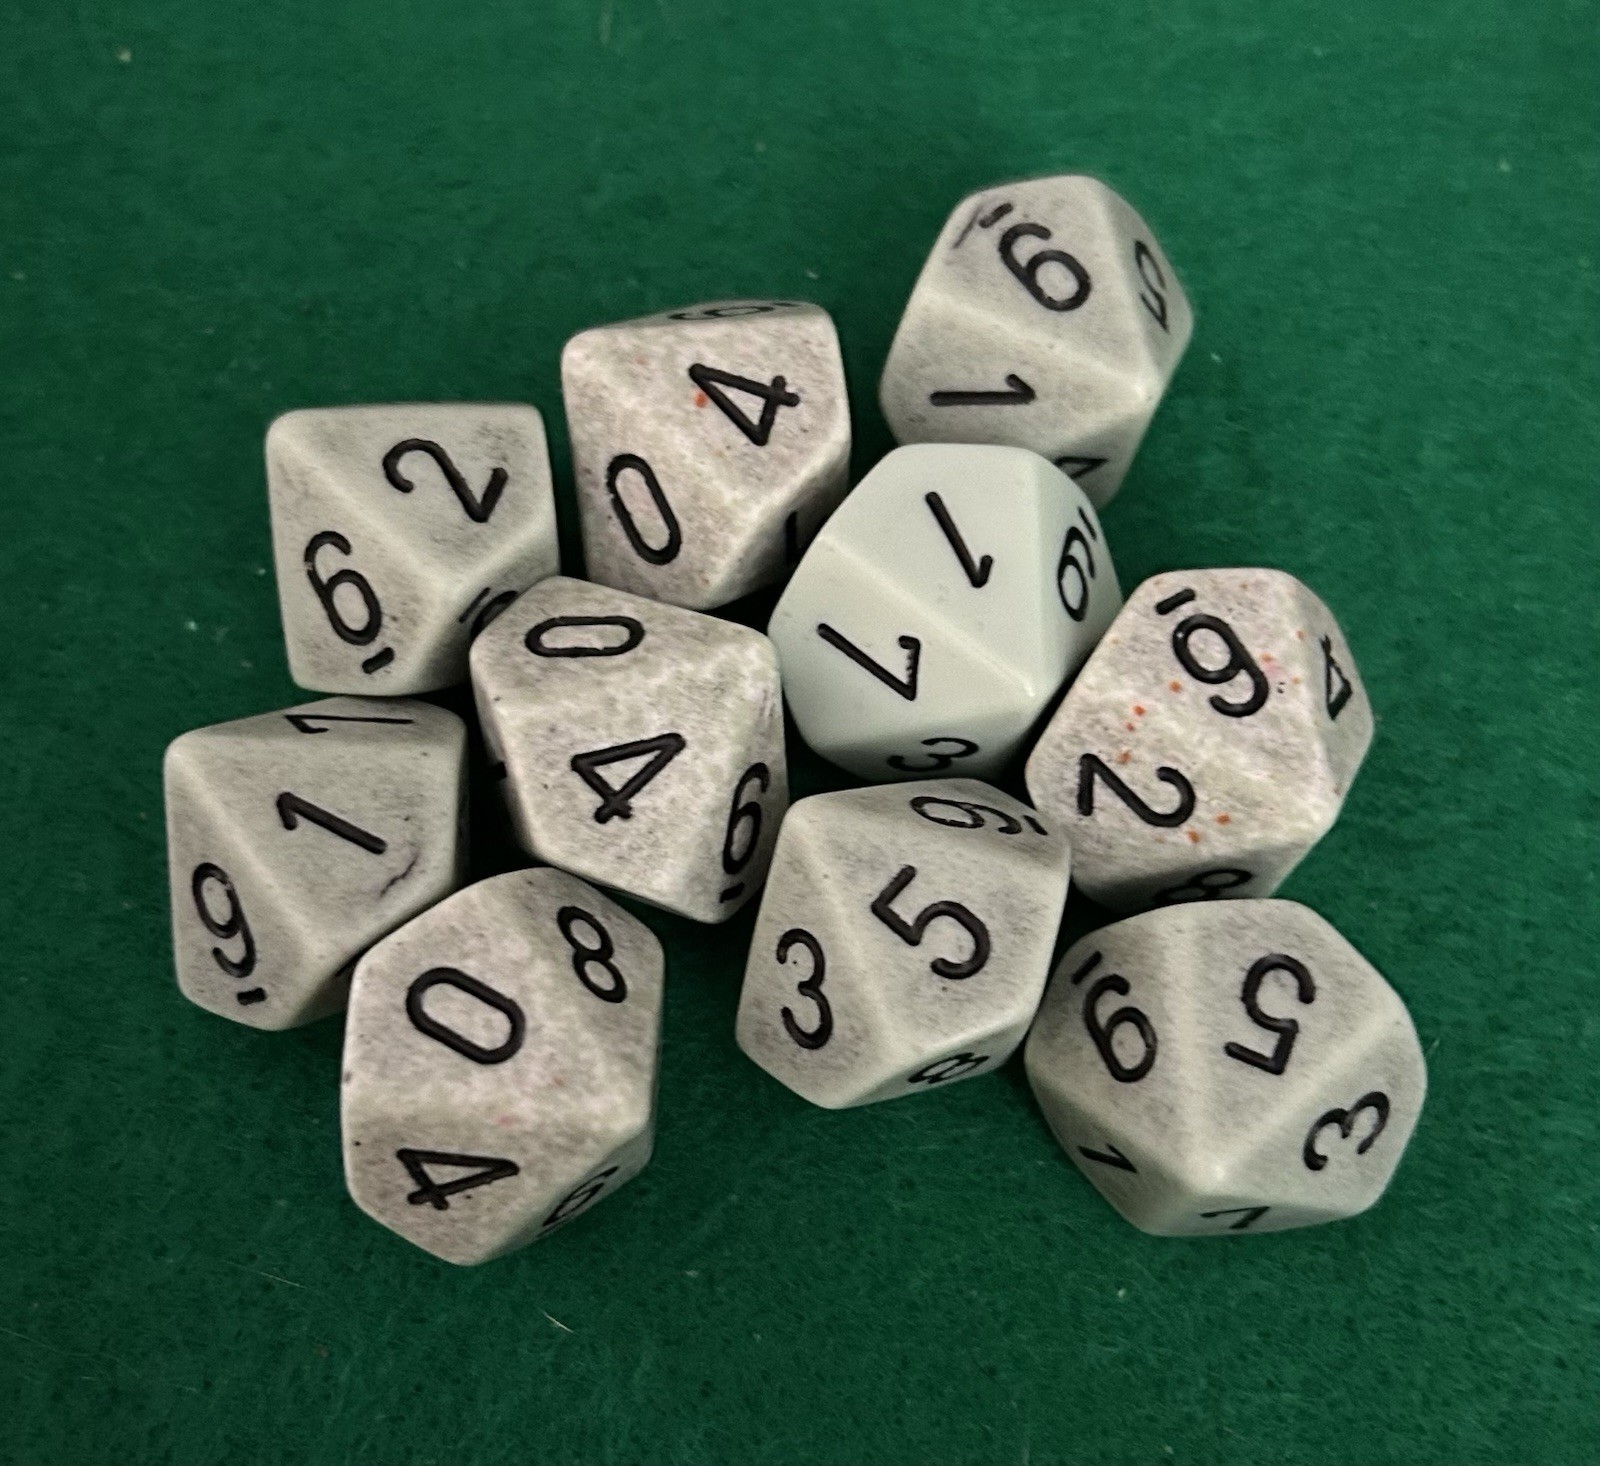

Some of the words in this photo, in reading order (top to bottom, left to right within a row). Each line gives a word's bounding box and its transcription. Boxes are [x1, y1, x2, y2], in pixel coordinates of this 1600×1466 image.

[979, 203, 1091, 311] 9
[689, 363, 799, 446] 4
[930, 374, 1035, 407] 1
[382, 438, 508, 523] 2
[606, 454, 681, 565] 0
[925, 491, 993, 588] 1
[304, 531, 395, 675] 6
[525, 616, 646, 657] 0
[818, 623, 921, 701] 7
[1155, 588, 1269, 717] 6
[1320, 634, 1353, 720] 4
[285, 714, 414, 733] 7
[887, 738, 979, 772] 3
[571, 732, 686, 824] 4
[910, 796, 1048, 835] 9
[1077, 753, 1196, 828] 2
[276, 792, 387, 854] 1
[719, 762, 769, 903] 6
[192, 862, 267, 1006] 9
[556, 906, 627, 1003] 8
[871, 864, 990, 980] 5
[406, 967, 525, 1064] 0
[776, 928, 833, 1050] 3
[1071, 951, 1157, 1083] 9
[1224, 953, 1316, 1076] 5
[1078, 1144, 1137, 1173] 1
[1303, 1091, 1390, 1171] 3
[397, 1148, 519, 1210] 4
[1200, 1206, 1270, 1229] 7
